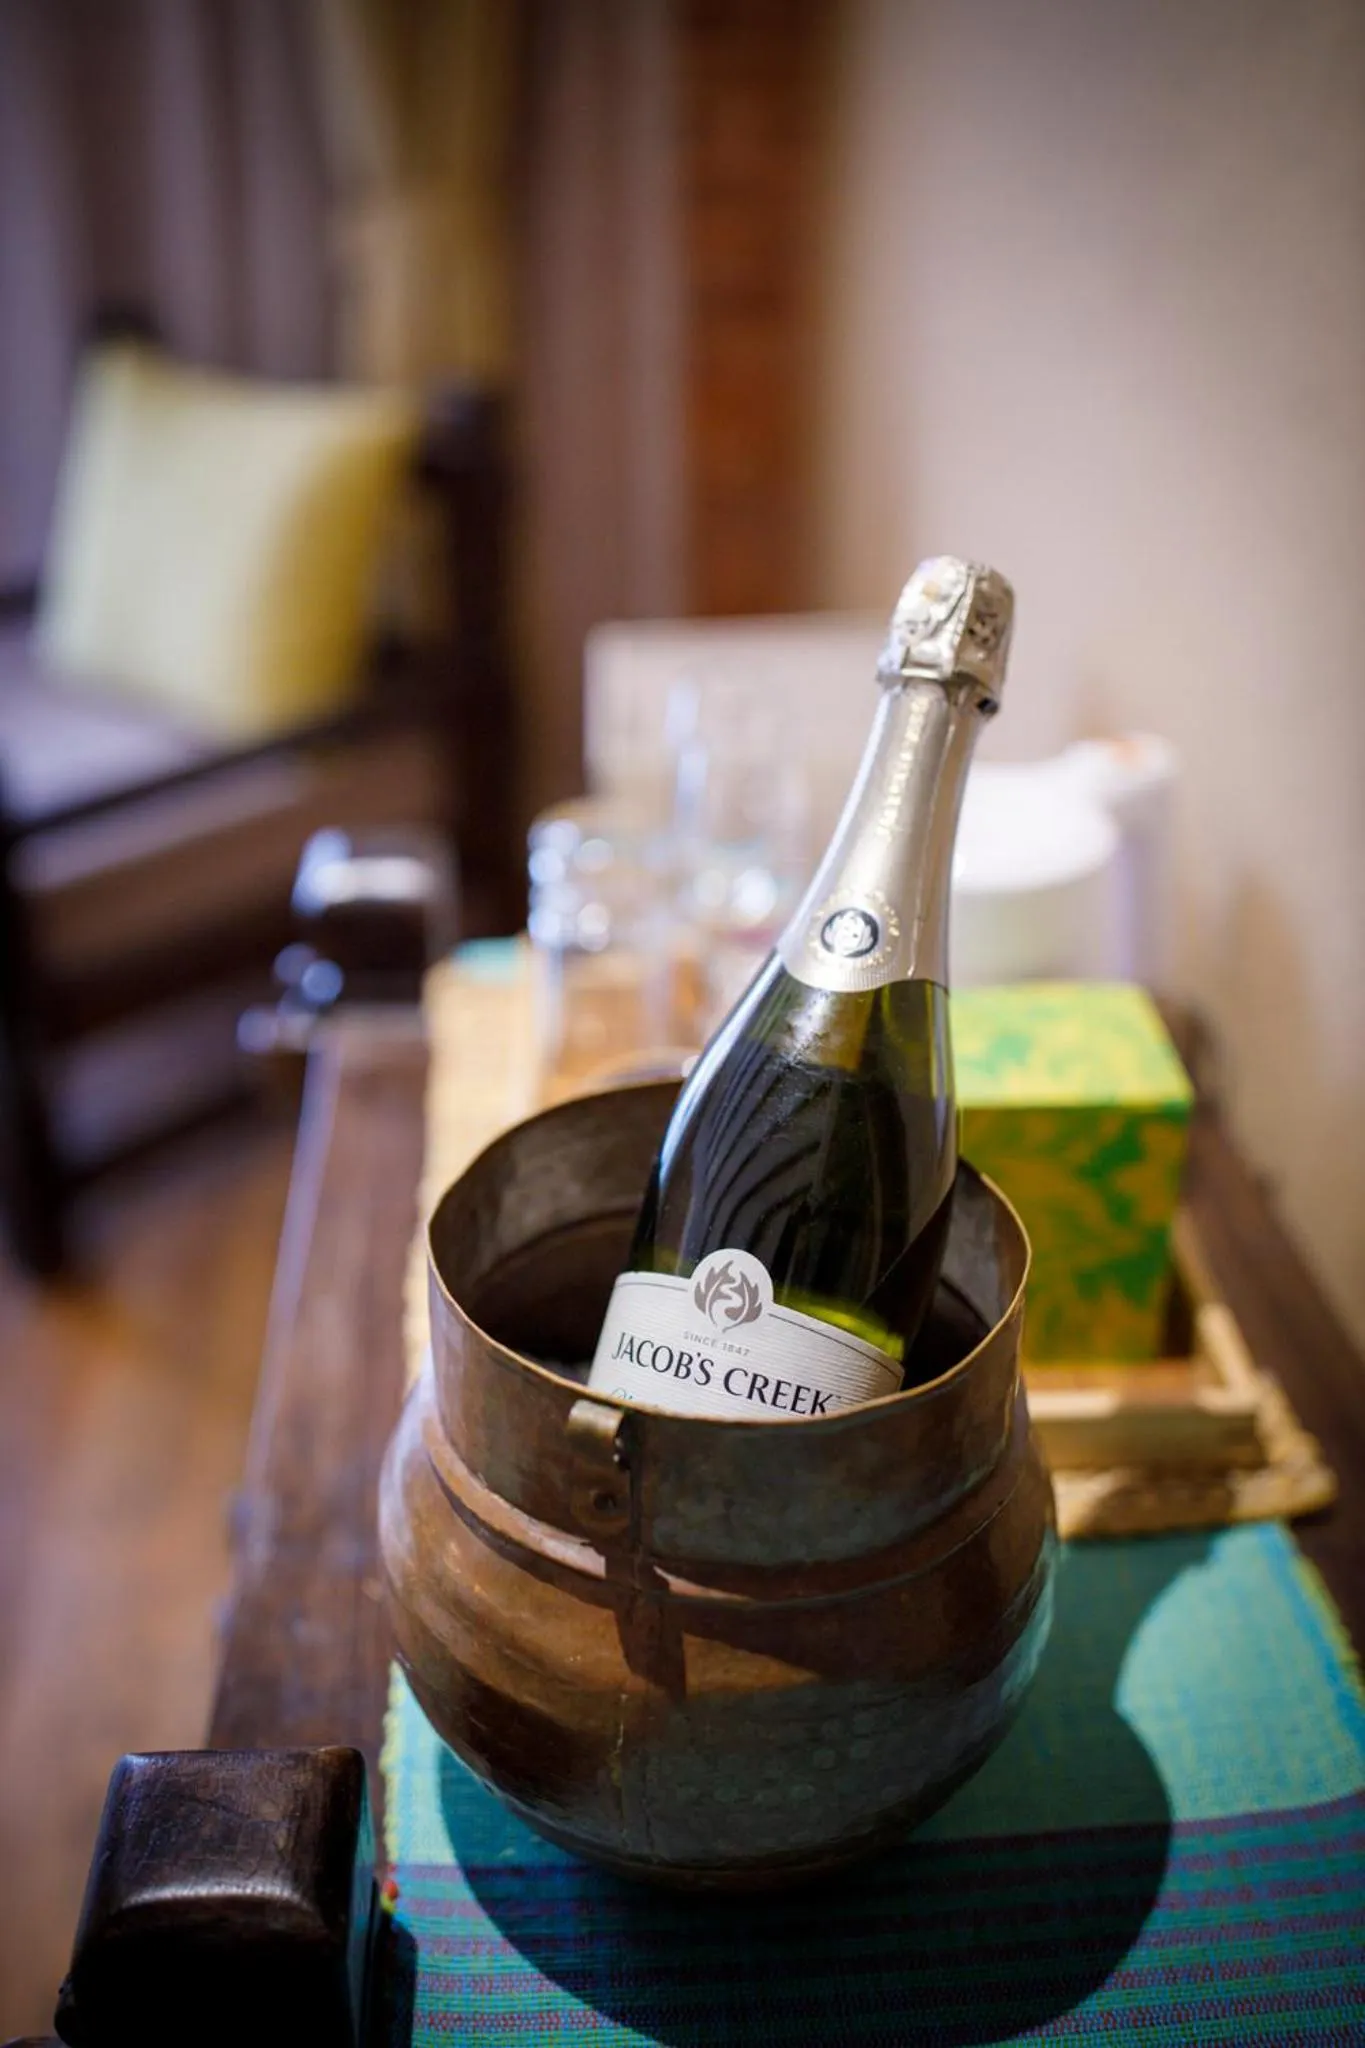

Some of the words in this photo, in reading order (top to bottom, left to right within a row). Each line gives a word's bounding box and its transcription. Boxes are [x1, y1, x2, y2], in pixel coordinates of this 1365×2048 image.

[683, 1331, 717, 1348] SINCE
[722, 1342, 750, 1357] 1847
[611, 1332, 714, 1386] JACOB'S
[723, 1367, 834, 1416] CREEK
